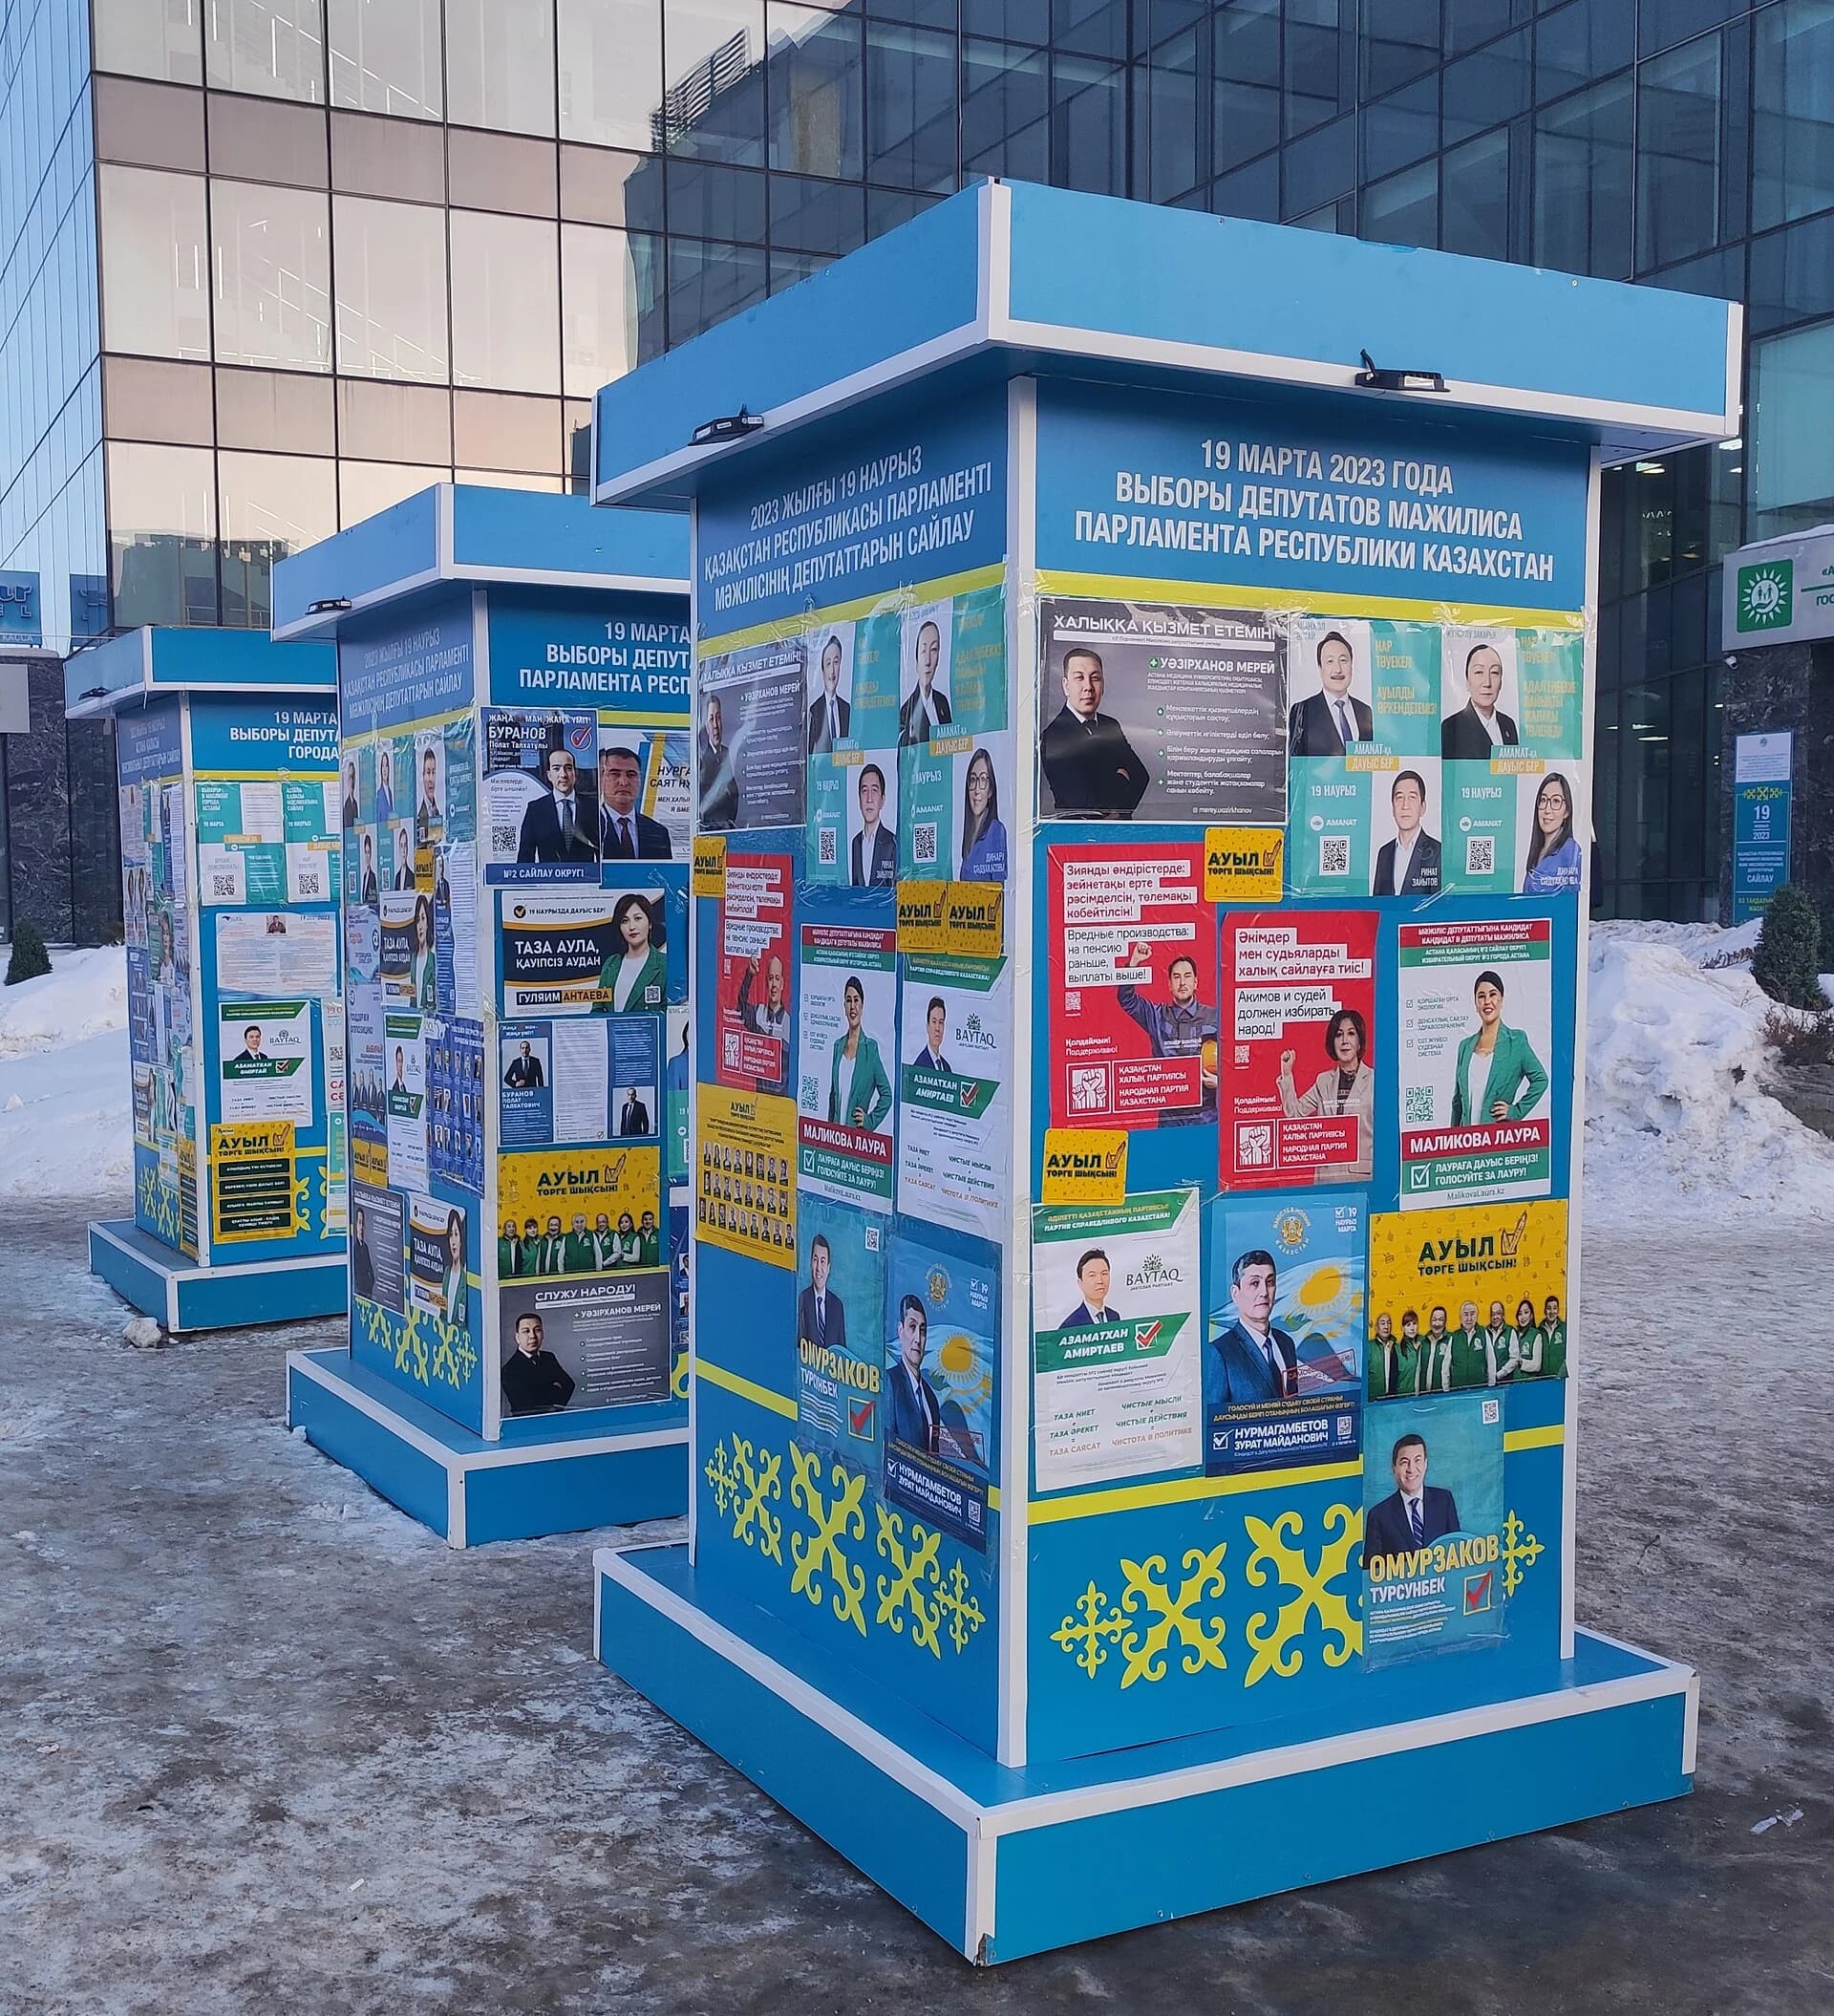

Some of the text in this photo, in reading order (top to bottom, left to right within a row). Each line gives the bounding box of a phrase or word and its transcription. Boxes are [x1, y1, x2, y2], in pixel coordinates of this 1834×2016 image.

[1201, 439, 1454, 496] 19 МАРТА 2023 ГОДА
[750, 444, 922, 531] 2023 ЖЫЛҒЫ 19 НАУРЫЗ
[1116, 471, 1524, 541] ВЫБОРЫ ДЕПУТАТОВ МАЖИЛИСА
[704, 461, 992, 584] ҚАЗАҚСТАН РЕСПУБЛИКАСЫ ПАРЛАМЕНТІ
[1076, 509, 1555, 583] ПАРЛАМЕНТА РЕСПУБЛИКИ КАЗАХСТАН
[715, 508, 974, 612] МӘЖІЛІСІНІҢ ДЕПУТАТТАРЫН САЙЛАУ
[605, 621, 691, 644] 19 МАРТА
[1054, 614, 1210, 636] ХАЛЫҚҚА ҚЫЗМЕТ
[546, 644, 627, 666] ВЫБОРЫ
[1161, 656, 1275, 675] УӘЗІРХАНОВ МЕРЕЙ
[435, 672, 462, 696] САЙЛАУ
[520, 669, 642, 693] ПАРЛАМЕНТА
[274, 712, 337, 724] 19 МАРТА
[230, 728, 289, 740] ВЫБОРЫ
[489, 726, 546, 740] БУРАНОВ
[288, 746, 339, 761] ГОРОДА
[650, 779, 676, 787] САЯТ
[1311, 785, 1321, 796] 19
[1461, 787, 1471, 799] 19
[915, 804, 945, 814] AMANAT
[1755, 804, 1770, 820] 19
[1473, 819, 1502, 827] AMANAT
[1753, 831, 1770, 840] 2023
[1208, 853, 1259, 866] АУЫЛ
[520, 869, 553, 879] САЙЛАУ
[555, 869, 584, 878] ОКРУГІ
[1067, 865, 1185, 876] Зиянды өндірістерде:
[1067, 879, 1153, 890] зейнетақы ерте
[1747, 874, 1774, 883] САЙЛАУ
[899, 905, 931, 918] АУЫЛ
[949, 906, 985, 919] АУЫЛ
[1068, 928, 1189, 941] Вредные производства:
[1239, 932, 1290, 945] Әкімдер
[515, 940, 599, 954] ТАЗА АУЛА,
[1068, 944, 1122, 954] на пенсию
[1239, 948, 1339, 961] мен судьяларды
[517, 956, 601, 969] ҚАУІПСІЗ АУДАН
[1068, 959, 1108, 971] раньше,
[1239, 961, 1364, 977] халық сайлауға тиіс!
[1068, 970, 1146, 982] выплаты выше!
[519, 991, 609, 1003] ГУЛЯИМ АНТАЕВА
[1238, 990, 1327, 1002] Акимов и судей
[1238, 1005, 1335, 1020] должен избирать
[1238, 1022, 1275, 1037] народ!
[955, 1028, 997, 1049] BAYTAQ
[1119, 1064, 1162, 1074] ҚАЗАҚСТАН
[914, 1074, 957, 1091] АЗАМАТХАН
[1147, 1072, 1186, 1082] ПАРТИЯСЫ
[1120, 1088, 1159, 1097] НАРОДНАЯ
[731, 1102, 750, 1114] АУЫЛ
[218, 1136, 268, 1148] АУЫЛ
[804, 1122, 854, 1148] МАЛИКОВА
[855, 1135, 886, 1157] ЛАУРА
[1411, 1130, 1541, 1153] МАЛИКОВА ЛАУРА
[1048, 1154, 1101, 1169] АУЫЛ
[1474, 1158, 1503, 1170] ДАУЫС
[537, 1170, 599, 1187] АУЫЛ
[1436, 1167, 1526, 1186] ГОЛОСУЙТЕ ЗА ЛАУРУ!
[569, 1185, 618, 1194] ШЫҚСЫН!
[1349, 1208, 1356, 1217] 19
[1418, 1236, 1494, 1262] АУЫЛ
[1418, 1258, 1517, 1276] ТӨРГЕ ШЫҚСЫН!
[1126, 1269, 1184, 1286] BAYTAQ
[536, 1284, 636, 1300] СЛУЖУ НАРОДУ!
[980, 1281, 989, 1294] 19
[581, 1302, 661, 1319] УӘЗІРХАНОВ МЕРЕЙ
[1059, 1328, 1128, 1345] АЗАМАТХАН
[1063, 1343, 1124, 1359] АМИРТАЕВ
[800, 1338, 880, 1394] ОМУРЗАКОВ
[1121, 1400, 1154, 1409] ЧИСТЫЕ
[1116, 1411, 1187, 1427] ЧИСТЫЕ ДЕЙСТВИЯ
[1235, 1420, 1328, 1439] НУРМАГАМБЕТОВ
[1071, 1444, 1100, 1452] САЯСАТ
[1112, 1435, 1146, 1446] ЧИСТОТА
[1234, 1432, 1329, 1450] ЗУРАТ МАЙДАНОВИЧ
[899, 1461, 962, 1504] НУРМАГАМБЕТОВ
[915, 1483, 962, 1517] МАЙДАНОВИЧ
[1370, 1534, 1500, 1582] ОМУРЗАКОВ
[1370, 1576, 1446, 1604] ТУРСУНБЕК
